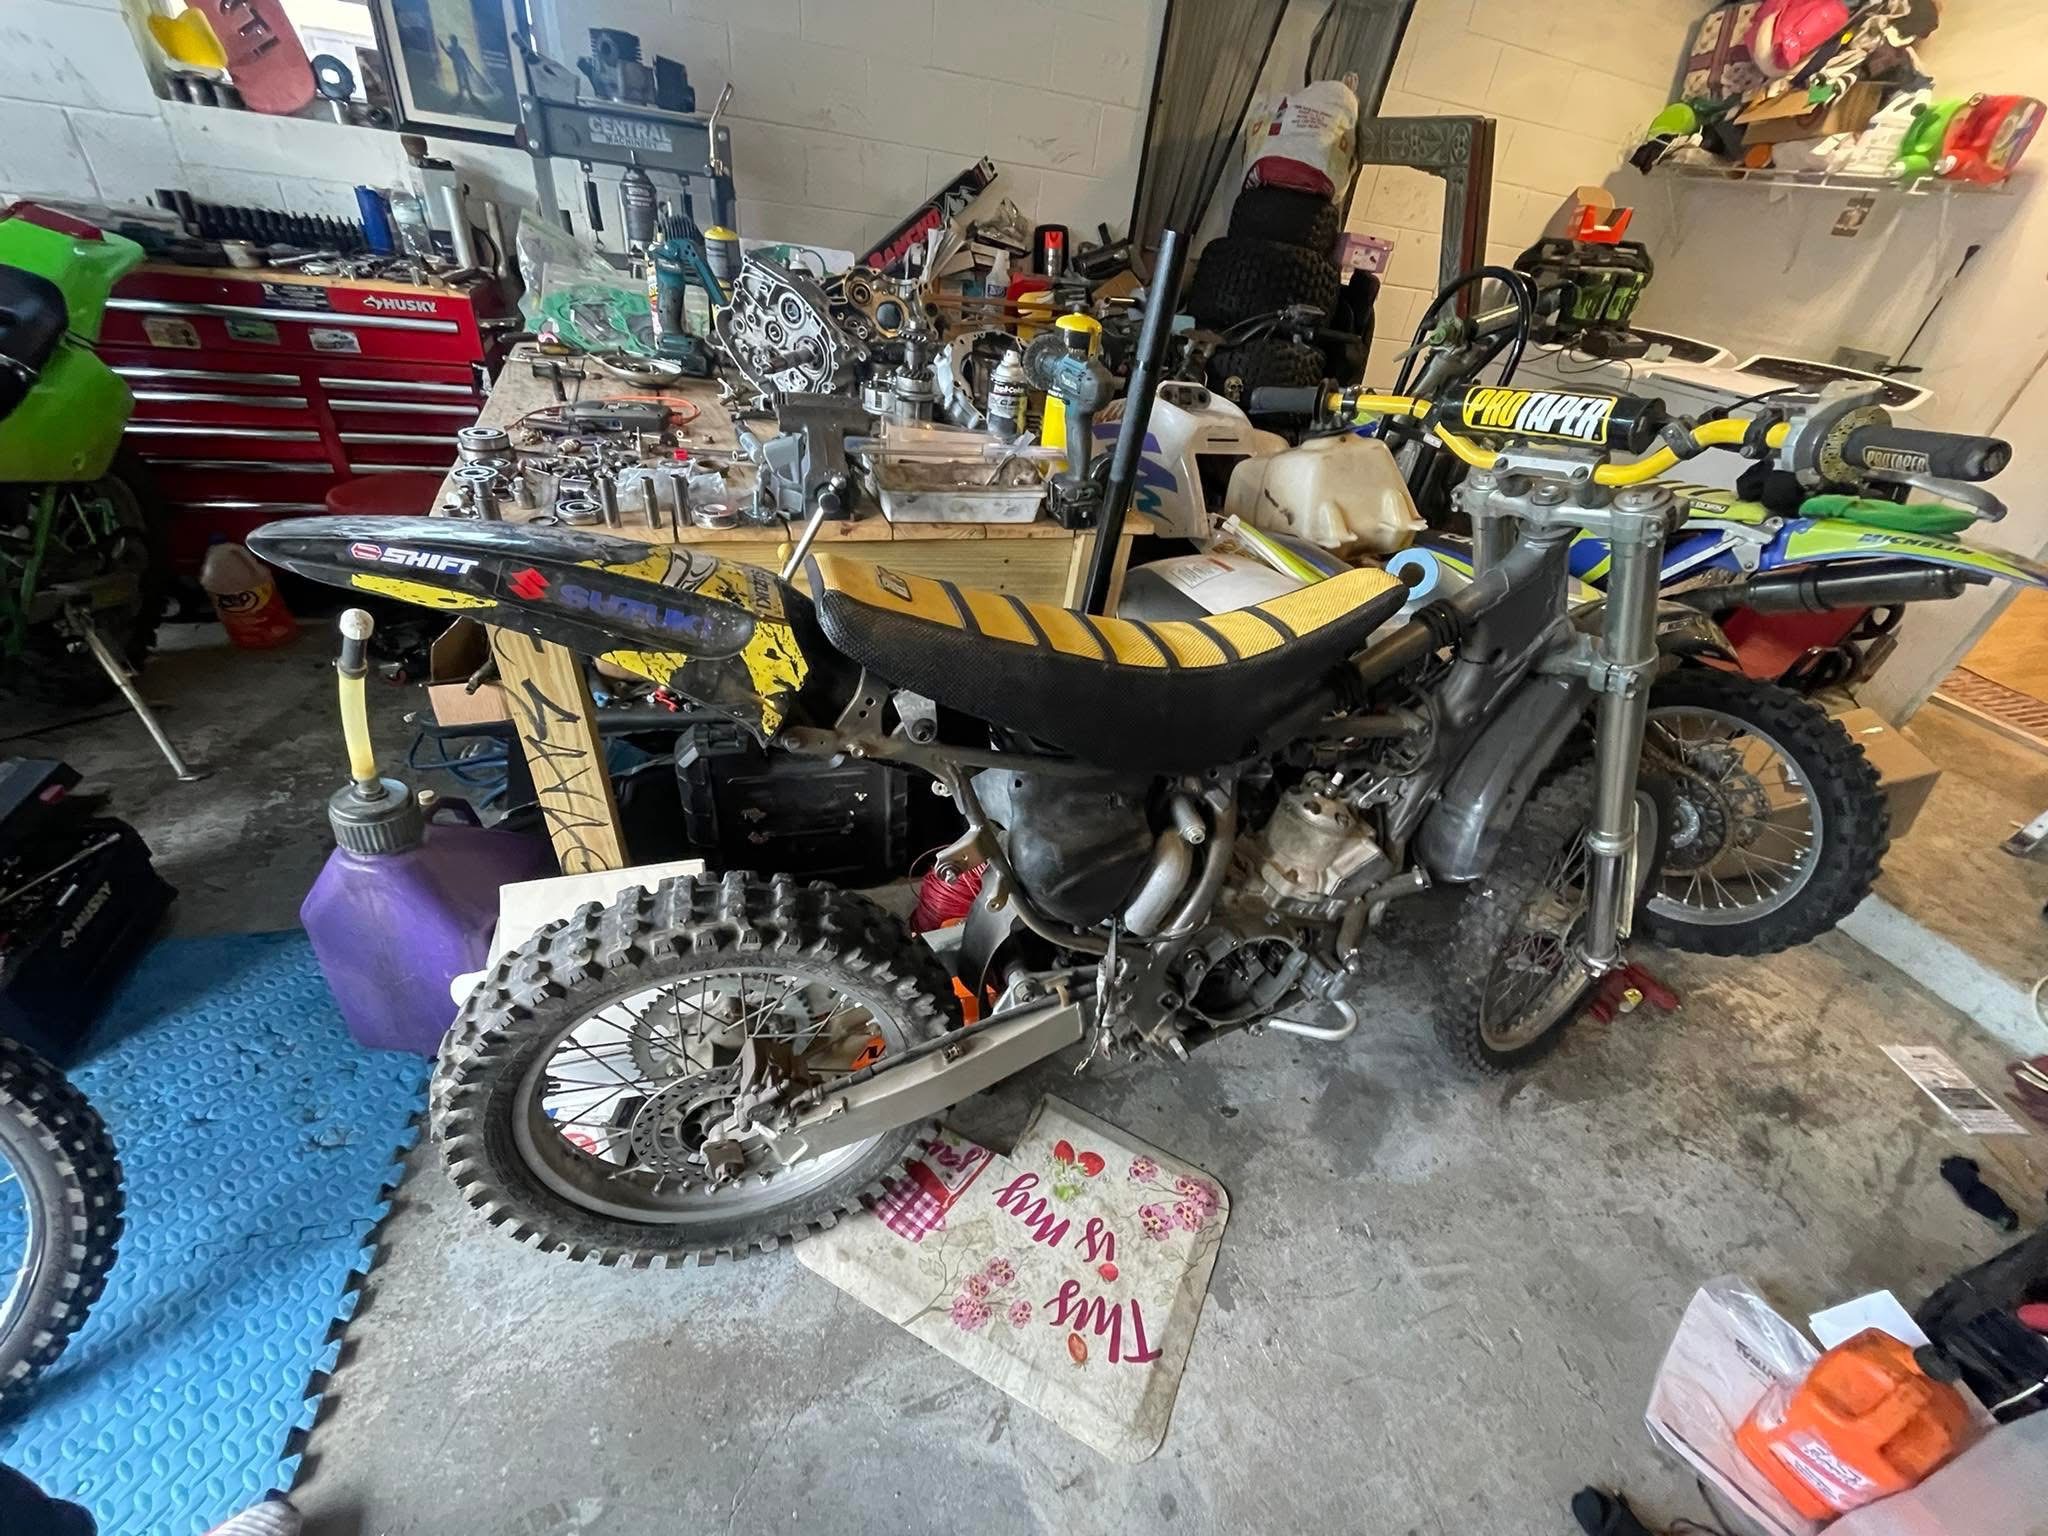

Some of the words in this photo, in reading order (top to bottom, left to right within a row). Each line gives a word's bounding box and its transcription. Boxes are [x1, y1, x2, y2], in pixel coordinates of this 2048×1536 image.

[588, 115, 672, 143] CENTRAL
[383, 297, 438, 313] HUSKY
[1859, 533, 1976, 555] MICHELIN
[381, 547, 480, 575] SHIFT
[992, 1172, 1071, 1247] my
[1074, 1218, 1116, 1262] is
[1043, 1279, 1163, 1364] This
